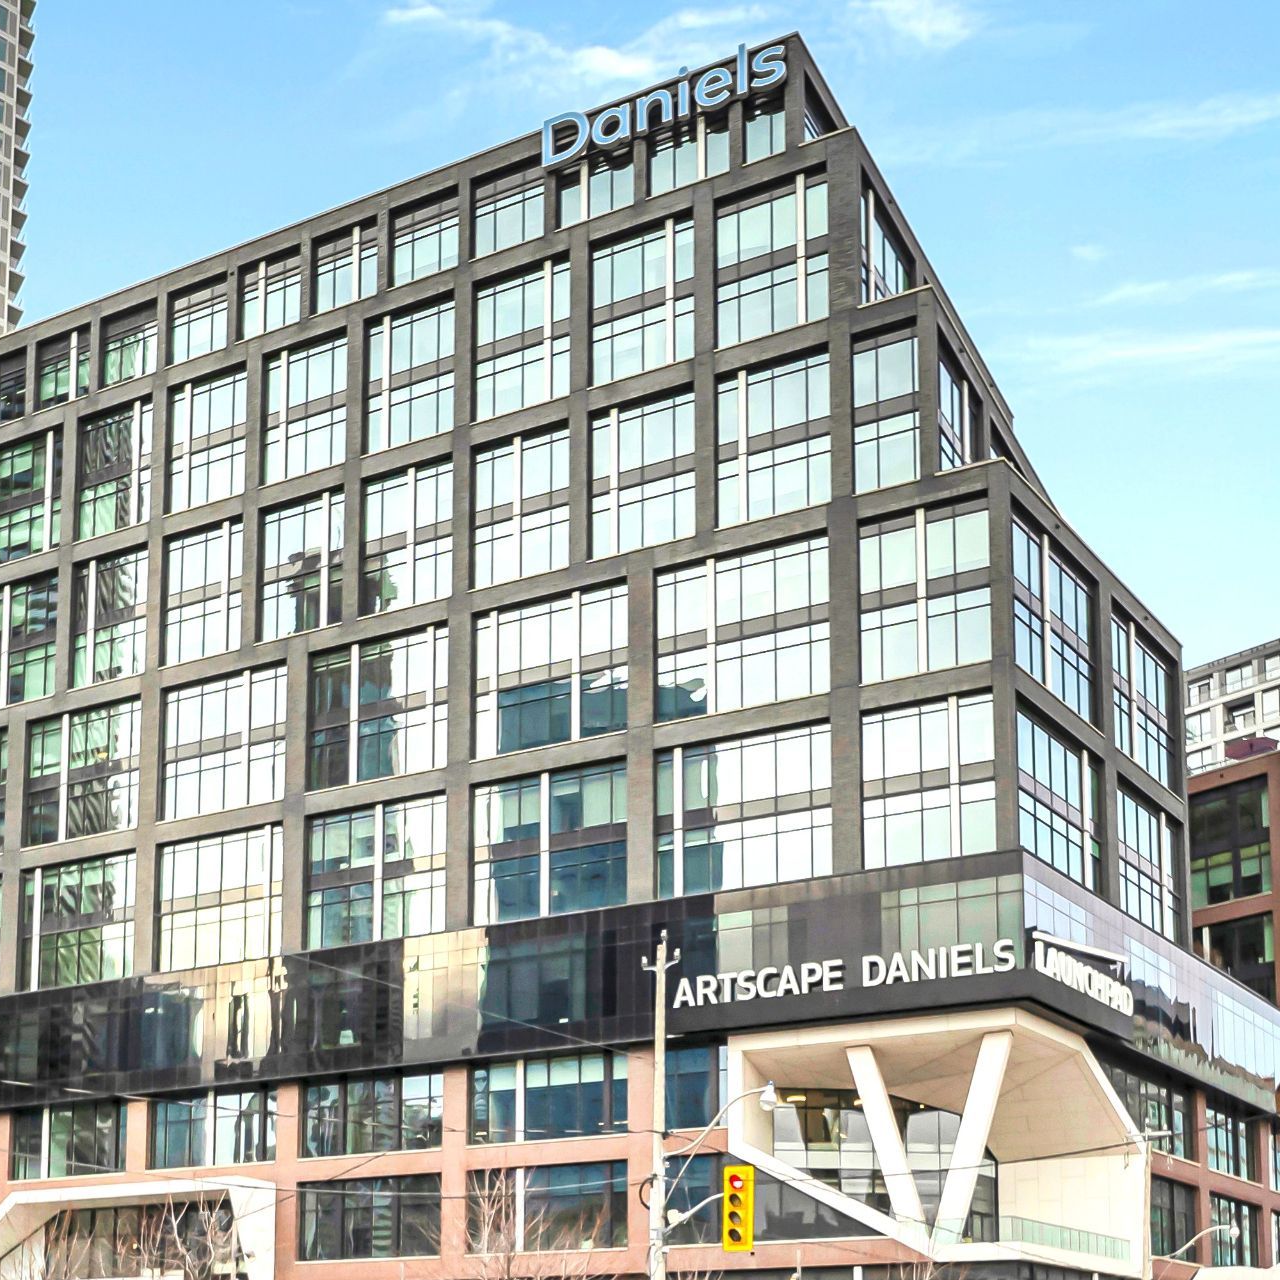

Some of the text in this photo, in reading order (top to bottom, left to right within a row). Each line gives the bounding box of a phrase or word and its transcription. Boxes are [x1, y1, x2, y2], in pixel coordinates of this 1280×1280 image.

[541, 43, 787, 167] Daniels
[672, 937, 1017, 1008] ARTSCAPE DANIELS
[1034, 940, 1134, 1017] LAUNCHPAD
